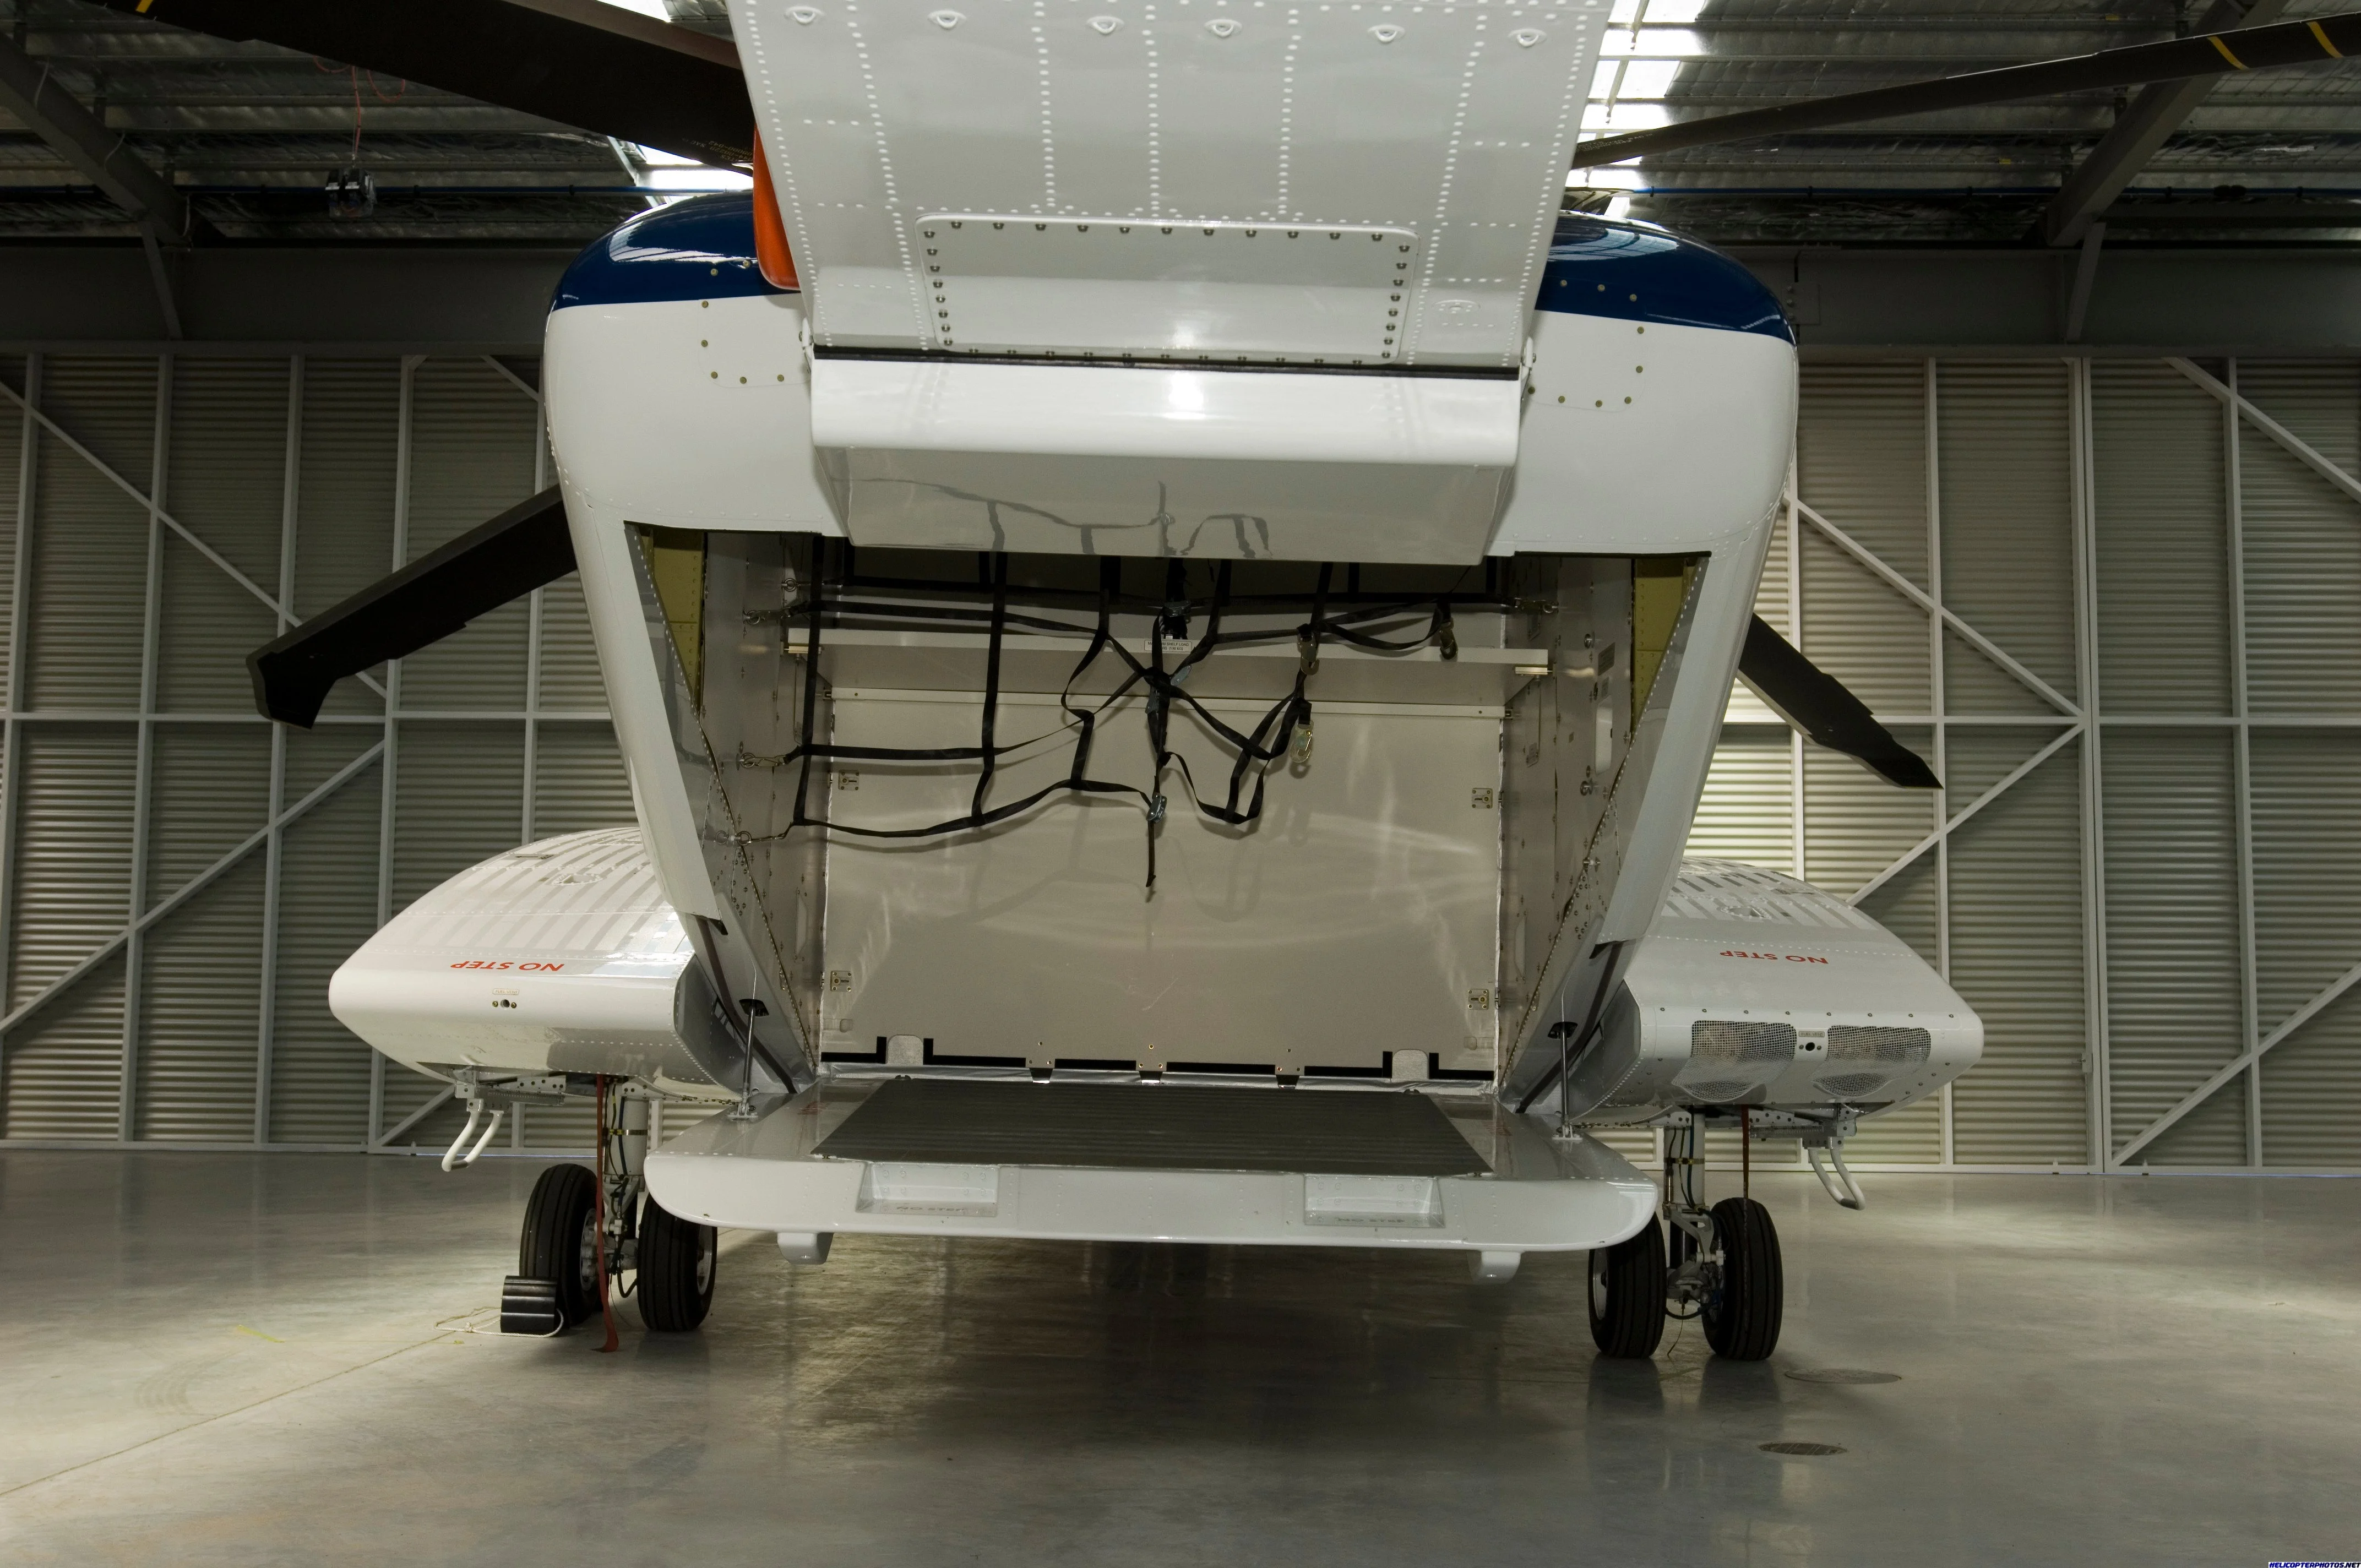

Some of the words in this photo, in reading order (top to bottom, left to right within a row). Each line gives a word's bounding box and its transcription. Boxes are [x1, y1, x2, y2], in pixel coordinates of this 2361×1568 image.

[1720, 950, 1778, 960] STEP
[1785, 955, 1829, 963] NO
[450, 961, 514, 970] STEP
[519, 962, 564, 971] NO
